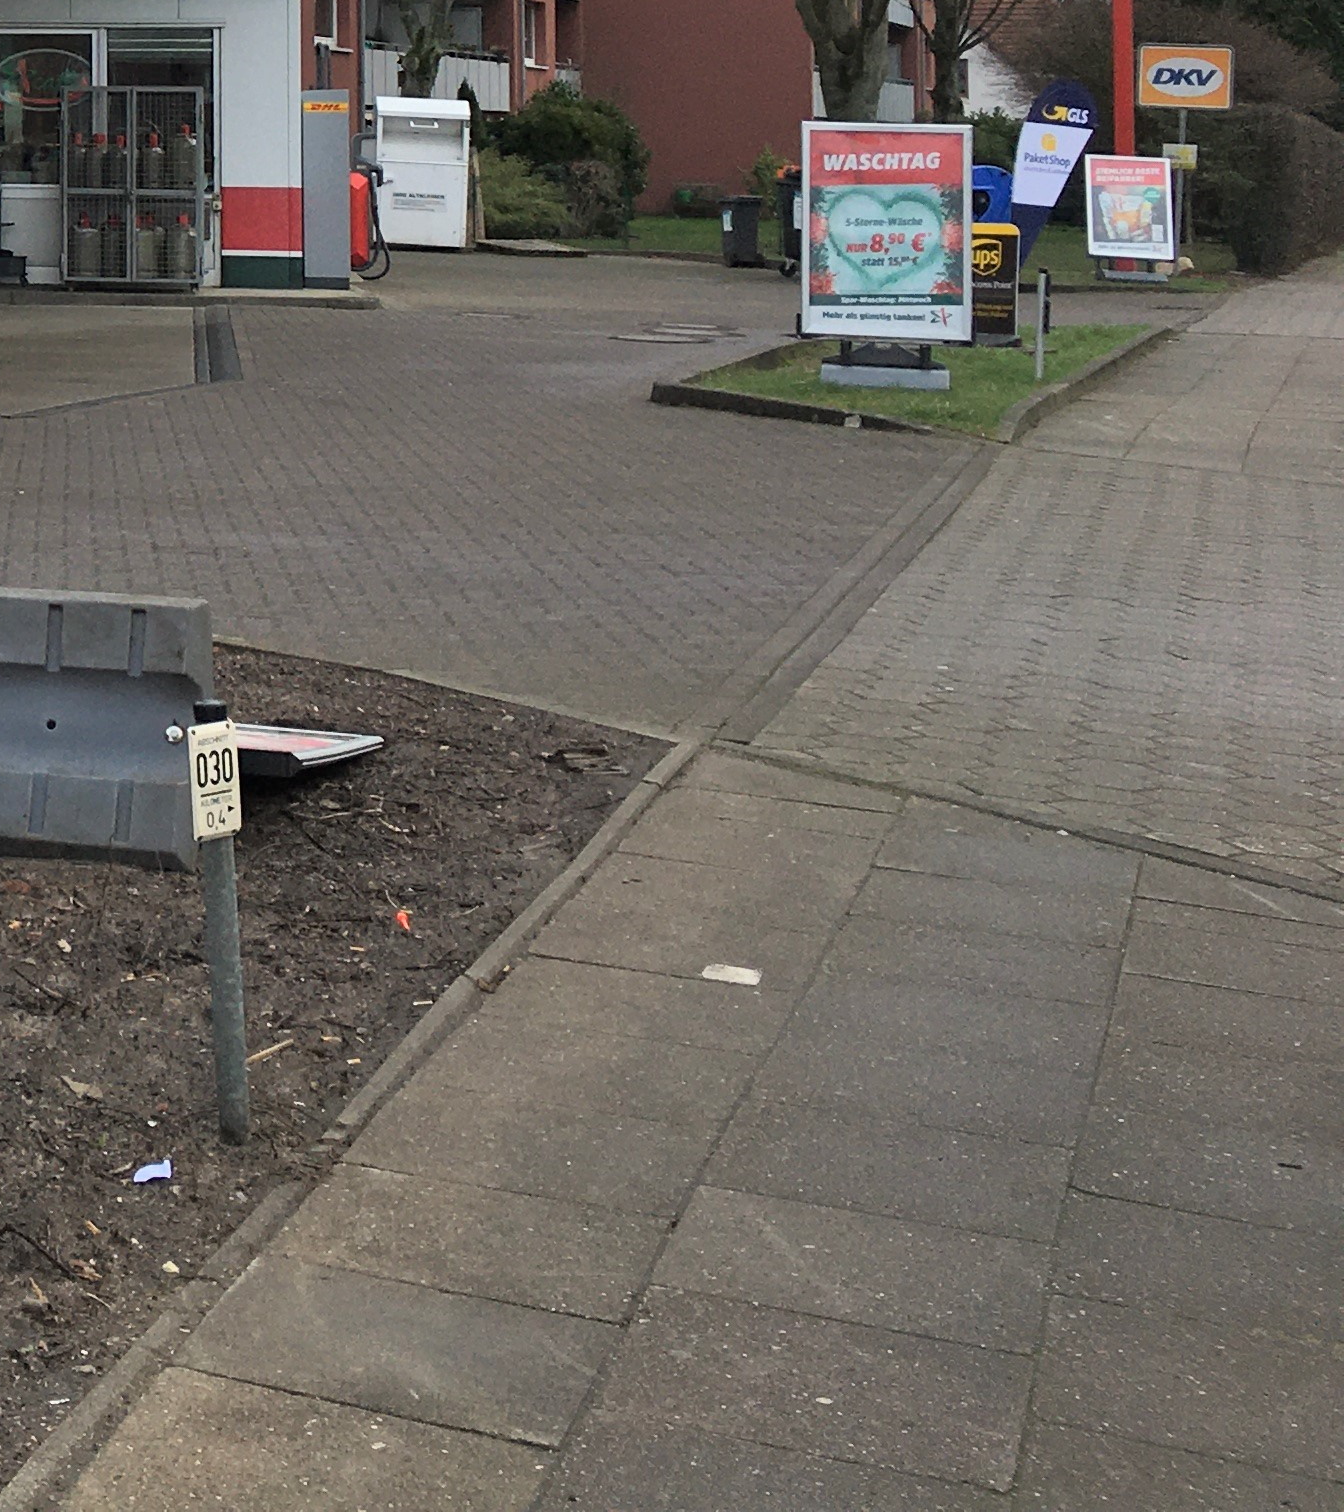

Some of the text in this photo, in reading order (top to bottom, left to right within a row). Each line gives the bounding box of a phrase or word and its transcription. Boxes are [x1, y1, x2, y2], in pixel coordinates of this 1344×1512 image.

[1152, 67, 1218, 86] DKV
[310, 103, 342, 111] DHL
[1067, 108, 1090, 124] GLS
[823, 152, 941, 171] WASCHTAG
[846, 243, 868, 253] NUR
[862, 257, 885, 267] statt
[972, 249, 999, 269] ups
[823, 311, 843, 319] Mehr
[196, 748, 234, 788] 030
[206, 809, 226, 831] 0,4
